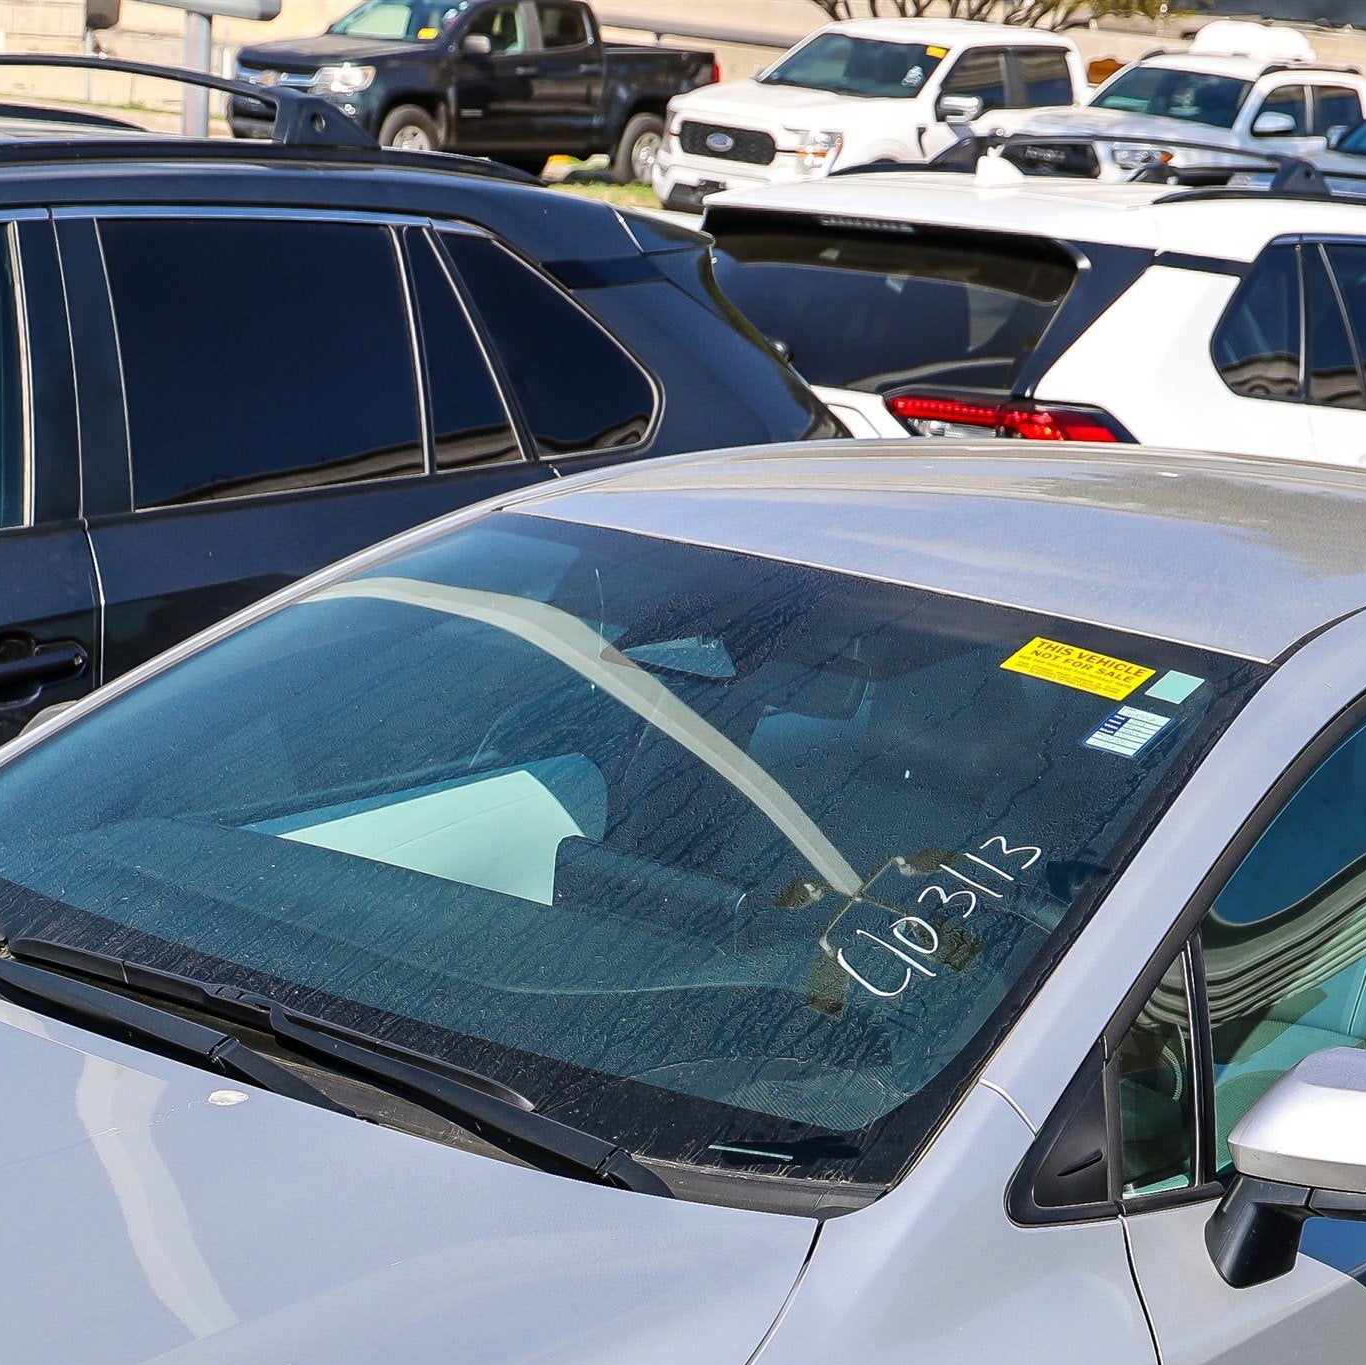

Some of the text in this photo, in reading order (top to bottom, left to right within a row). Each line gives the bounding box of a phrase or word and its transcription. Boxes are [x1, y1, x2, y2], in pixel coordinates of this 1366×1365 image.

[1030, 650, 1136, 683] NOT FOR SALE
[1036, 640, 1074, 656] THIS
[1077, 651, 1147, 677] VEHICLE
[837, 836, 1042, 997] C103113
